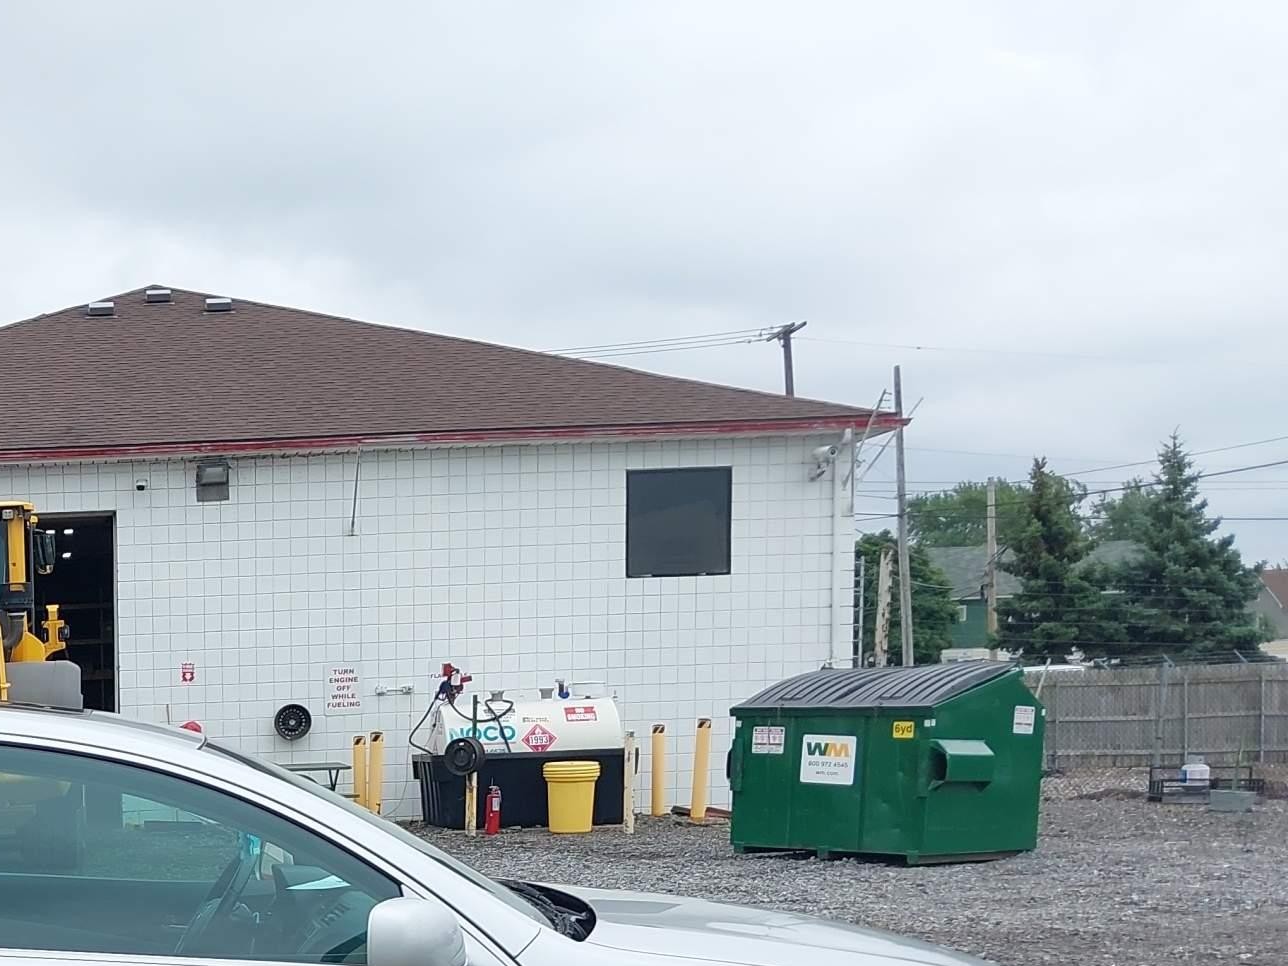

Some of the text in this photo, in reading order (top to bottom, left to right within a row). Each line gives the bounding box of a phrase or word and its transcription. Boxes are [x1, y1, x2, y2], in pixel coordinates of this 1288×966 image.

[329, 676, 359, 684] ENGINE
[449, 725, 516, 742] NOCO
[894, 723, 913, 735] 6yd
[530, 735, 549, 744] 1993
[806, 742, 850, 757] WM
